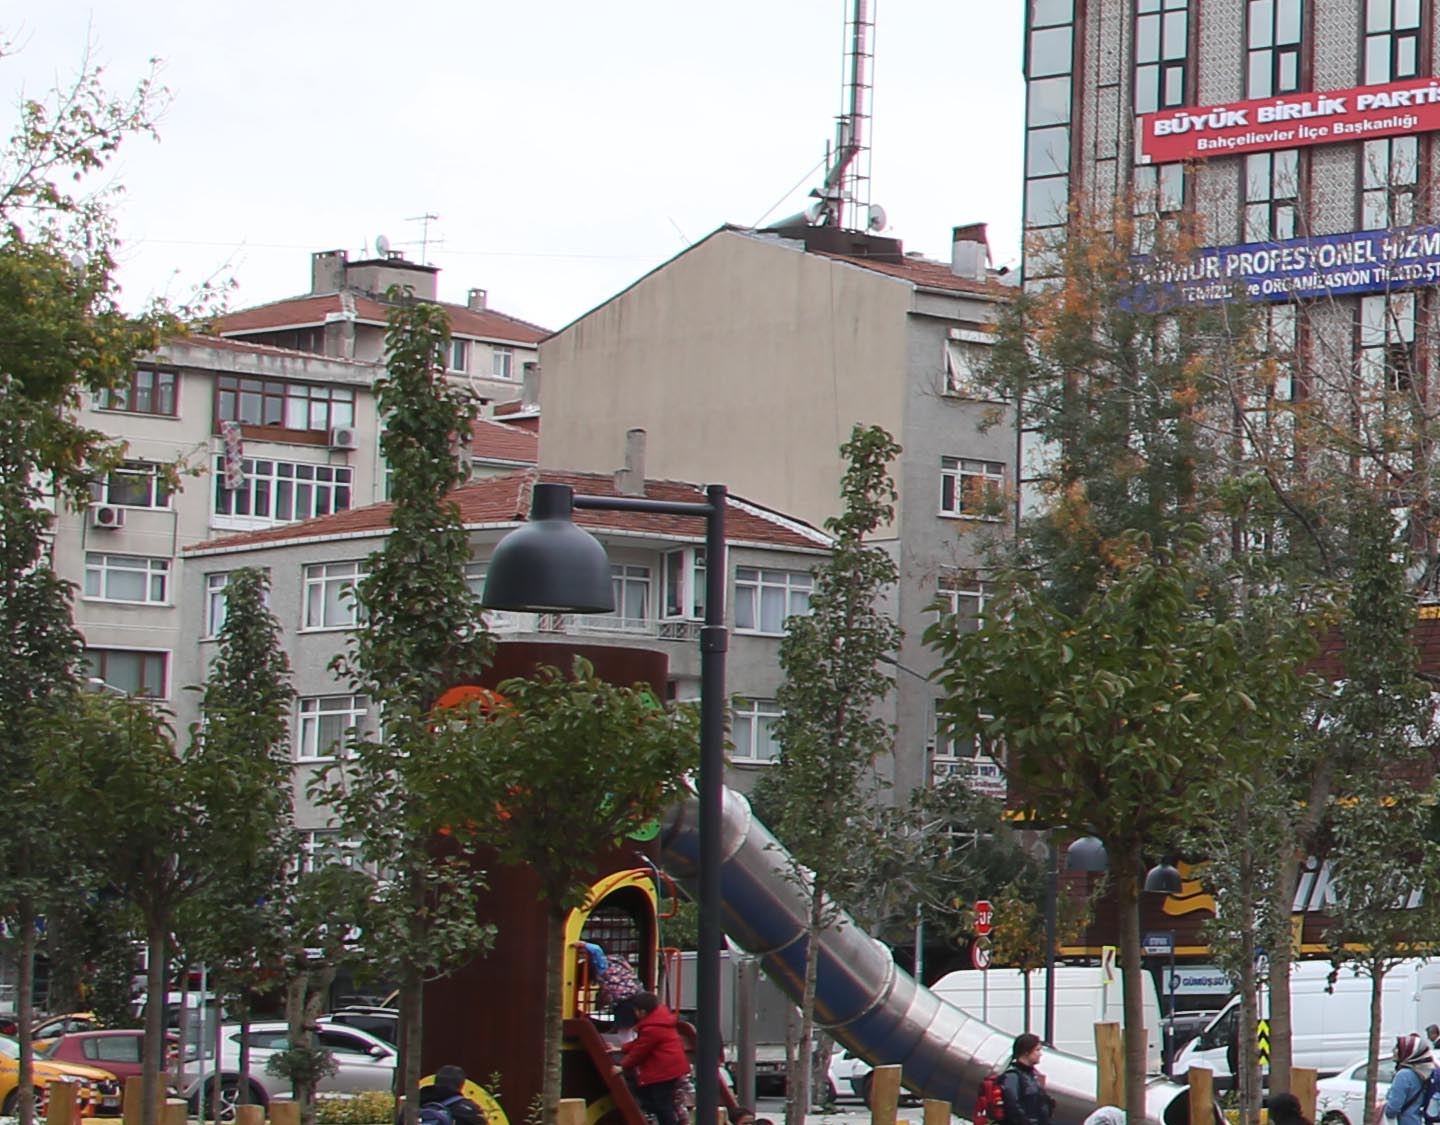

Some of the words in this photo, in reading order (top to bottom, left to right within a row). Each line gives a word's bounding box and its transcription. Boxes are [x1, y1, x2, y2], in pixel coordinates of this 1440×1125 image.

[1153, 107, 1249, 137] BÜYÜK
[1257, 95, 1347, 124] BİRLİK
[1196, 127, 1296, 151] Bahçelievler
[1298, 123, 1329, 142] İlçe
[1333, 114, 1418, 137] Başkanlığı
[1226, 238, 1377, 277] PROFESYONEL
[1262, 267, 1370, 295] ORGANİZASYON
